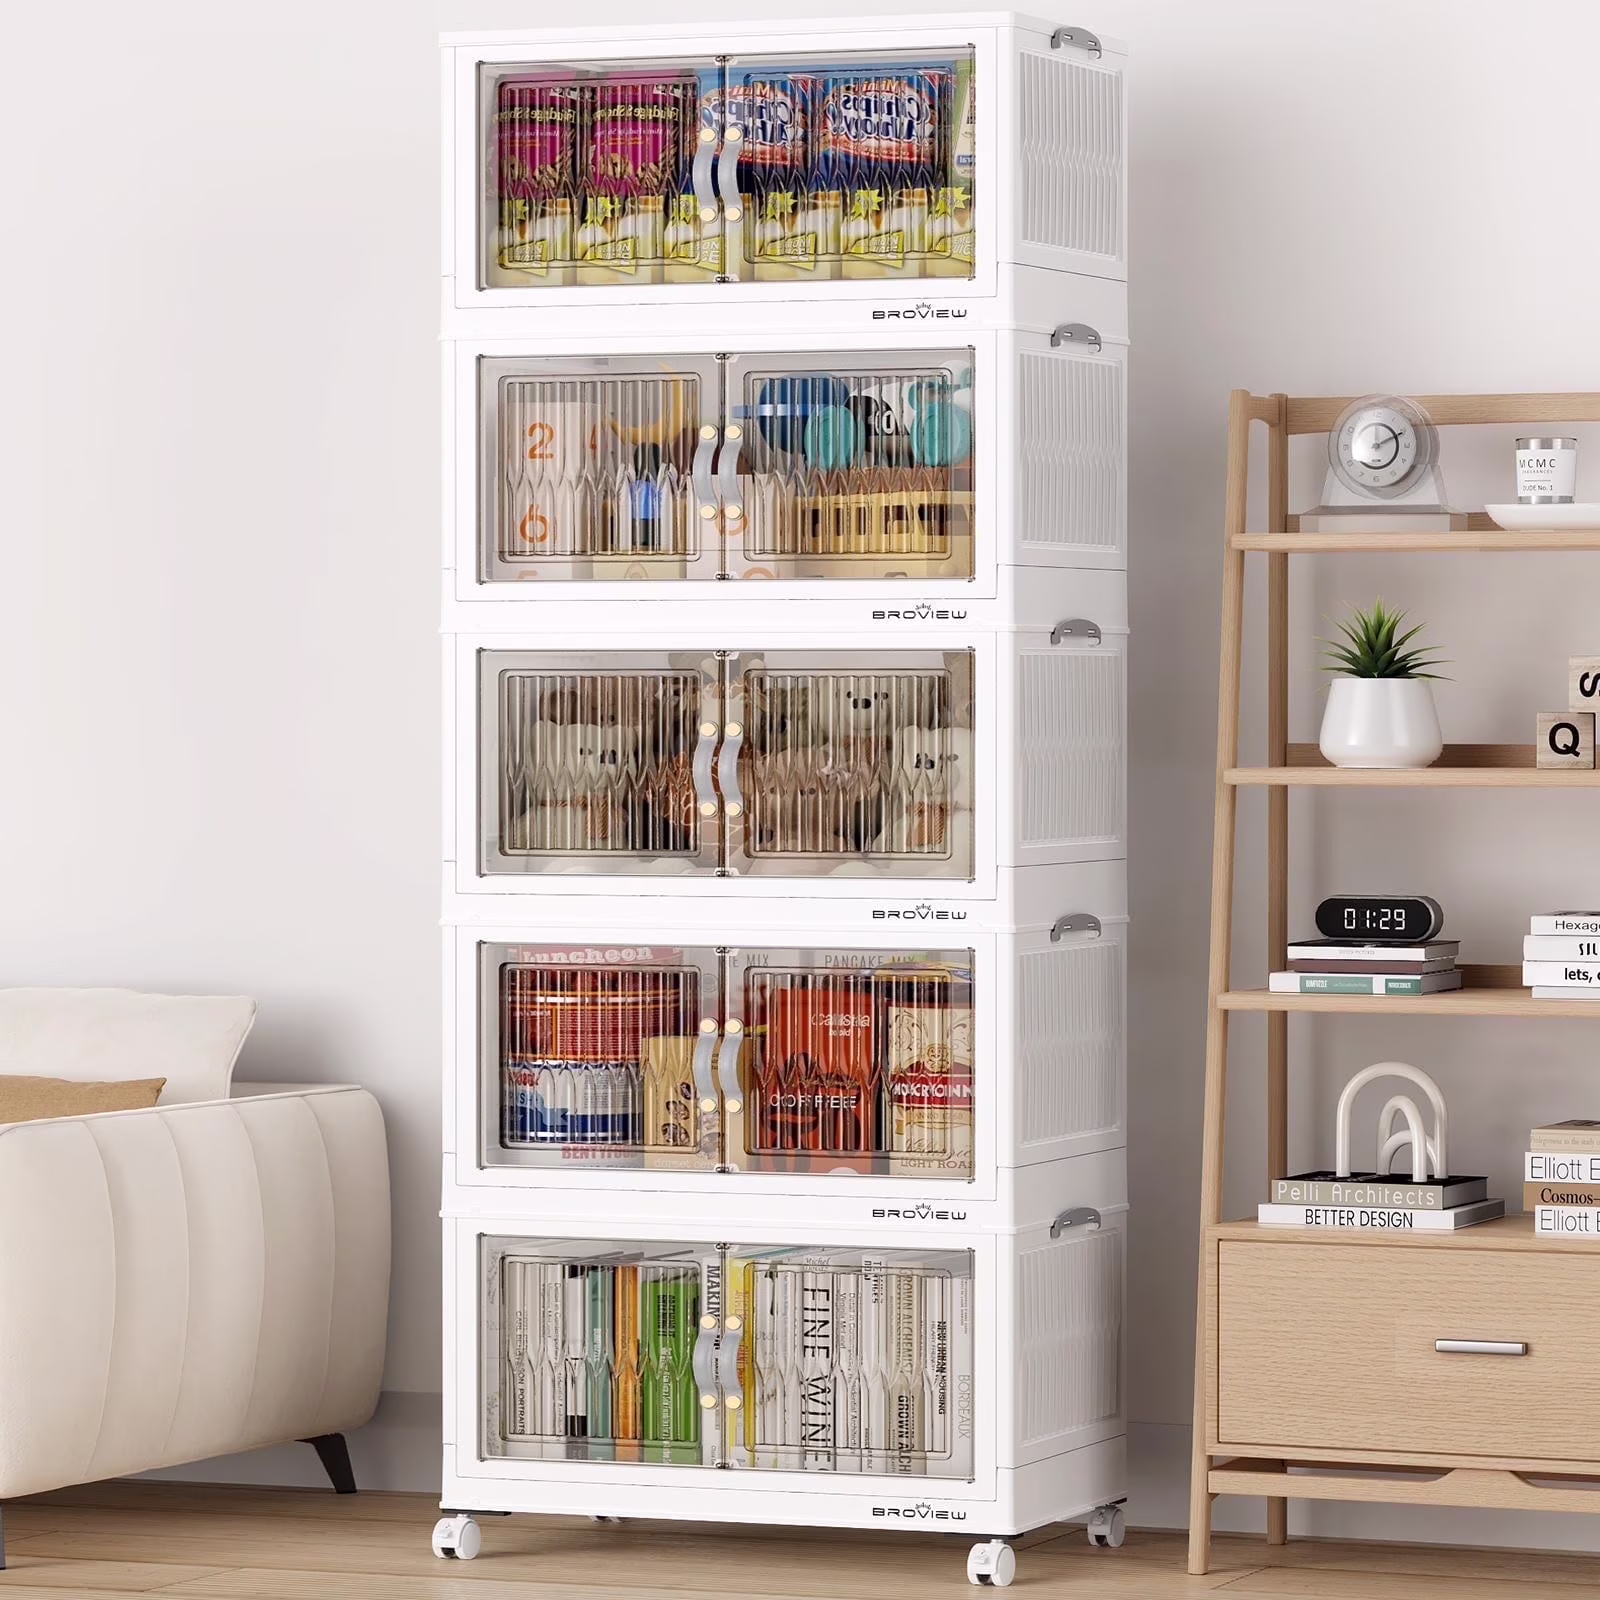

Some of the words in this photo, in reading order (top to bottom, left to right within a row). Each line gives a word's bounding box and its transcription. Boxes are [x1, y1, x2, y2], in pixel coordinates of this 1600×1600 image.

[873, 309, 967, 320] BROVIEW
[527, 421, 555, 460] 2
[1519, 458, 1556, 469] MCMC
[519, 503, 549, 544] 6
[873, 610, 967, 620] BROVIEW
[1548, 722, 1581, 758] Q
[873, 910, 967, 920] BROVIEW
[1344, 908, 1406, 930] 01:29
[746, 953, 769, 966] MIX
[824, 954, 885, 968] PANCAKE
[1564, 967, 1593, 984] lets,
[1530, 1156, 1582, 1180] Elliott
[1277, 1181, 1320, 1202] Pelli
[1331, 1183, 1435, 1206] Architects
[873, 1209, 967, 1220] BROVIEW
[1305, 1208, 1356, 1227] BETTER
[1359, 1210, 1413, 1228] DESIGN
[1540, 1209, 1589, 1232] Elliott
[803, 1287, 830, 1360] FINE
[517, 1388, 526, 1435] PORTRAITS
[957, 1374, 971, 1440] BORDEAUX
[873, 1507, 967, 1519] BROVIEW
